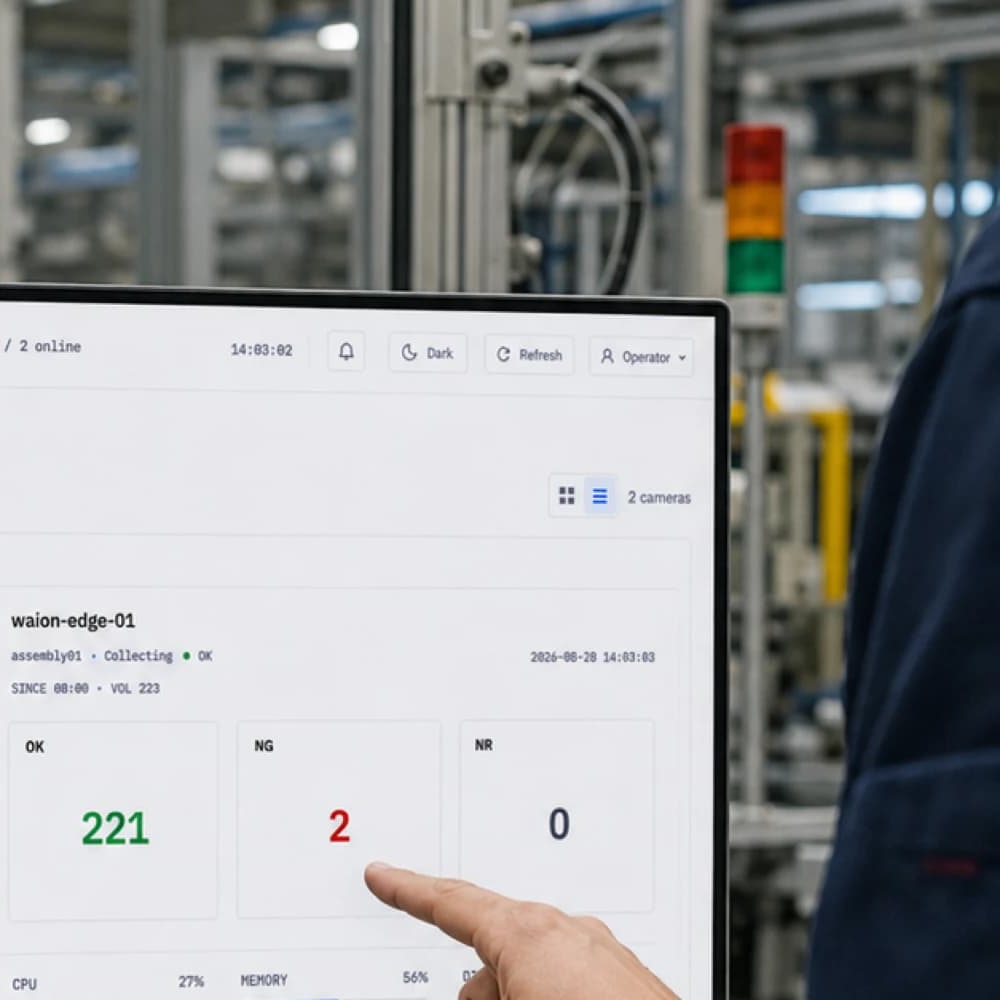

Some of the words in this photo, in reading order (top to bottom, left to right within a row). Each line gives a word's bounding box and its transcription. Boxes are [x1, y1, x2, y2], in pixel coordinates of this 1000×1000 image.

[20, 339, 28, 352] 2
[35, 340, 81, 353] online
[231, 343, 292, 356] 14:03:02
[427, 347, 454, 359] Dark
[520, 349, 562, 361] Refresh
[622, 351, 670, 365] Operator
[628, 490, 636, 504] 2
[639, 493, 691, 504] cameras
[11, 612, 135, 632] waion-edge-01
[11, 649, 81, 664] assembly01
[104, 649, 173, 664] Collecting
[198, 650, 212, 661] OK
[11, 682, 46, 694] SINCE
[111, 683, 132, 694] VOL
[139, 682, 160, 694] 223
[25, 740, 44, 753] OK
[255, 740, 273, 752] NG
[475, 738, 493, 751] NR
[82, 811, 149, 845] 221
[330, 809, 350, 842] 2
[549, 807, 569, 840] 0
[179, 975, 204, 988] 27%
[241, 974, 287, 986] MEMORY
[403, 971, 429, 984] 56%
[12, 978, 37, 991] CPU
